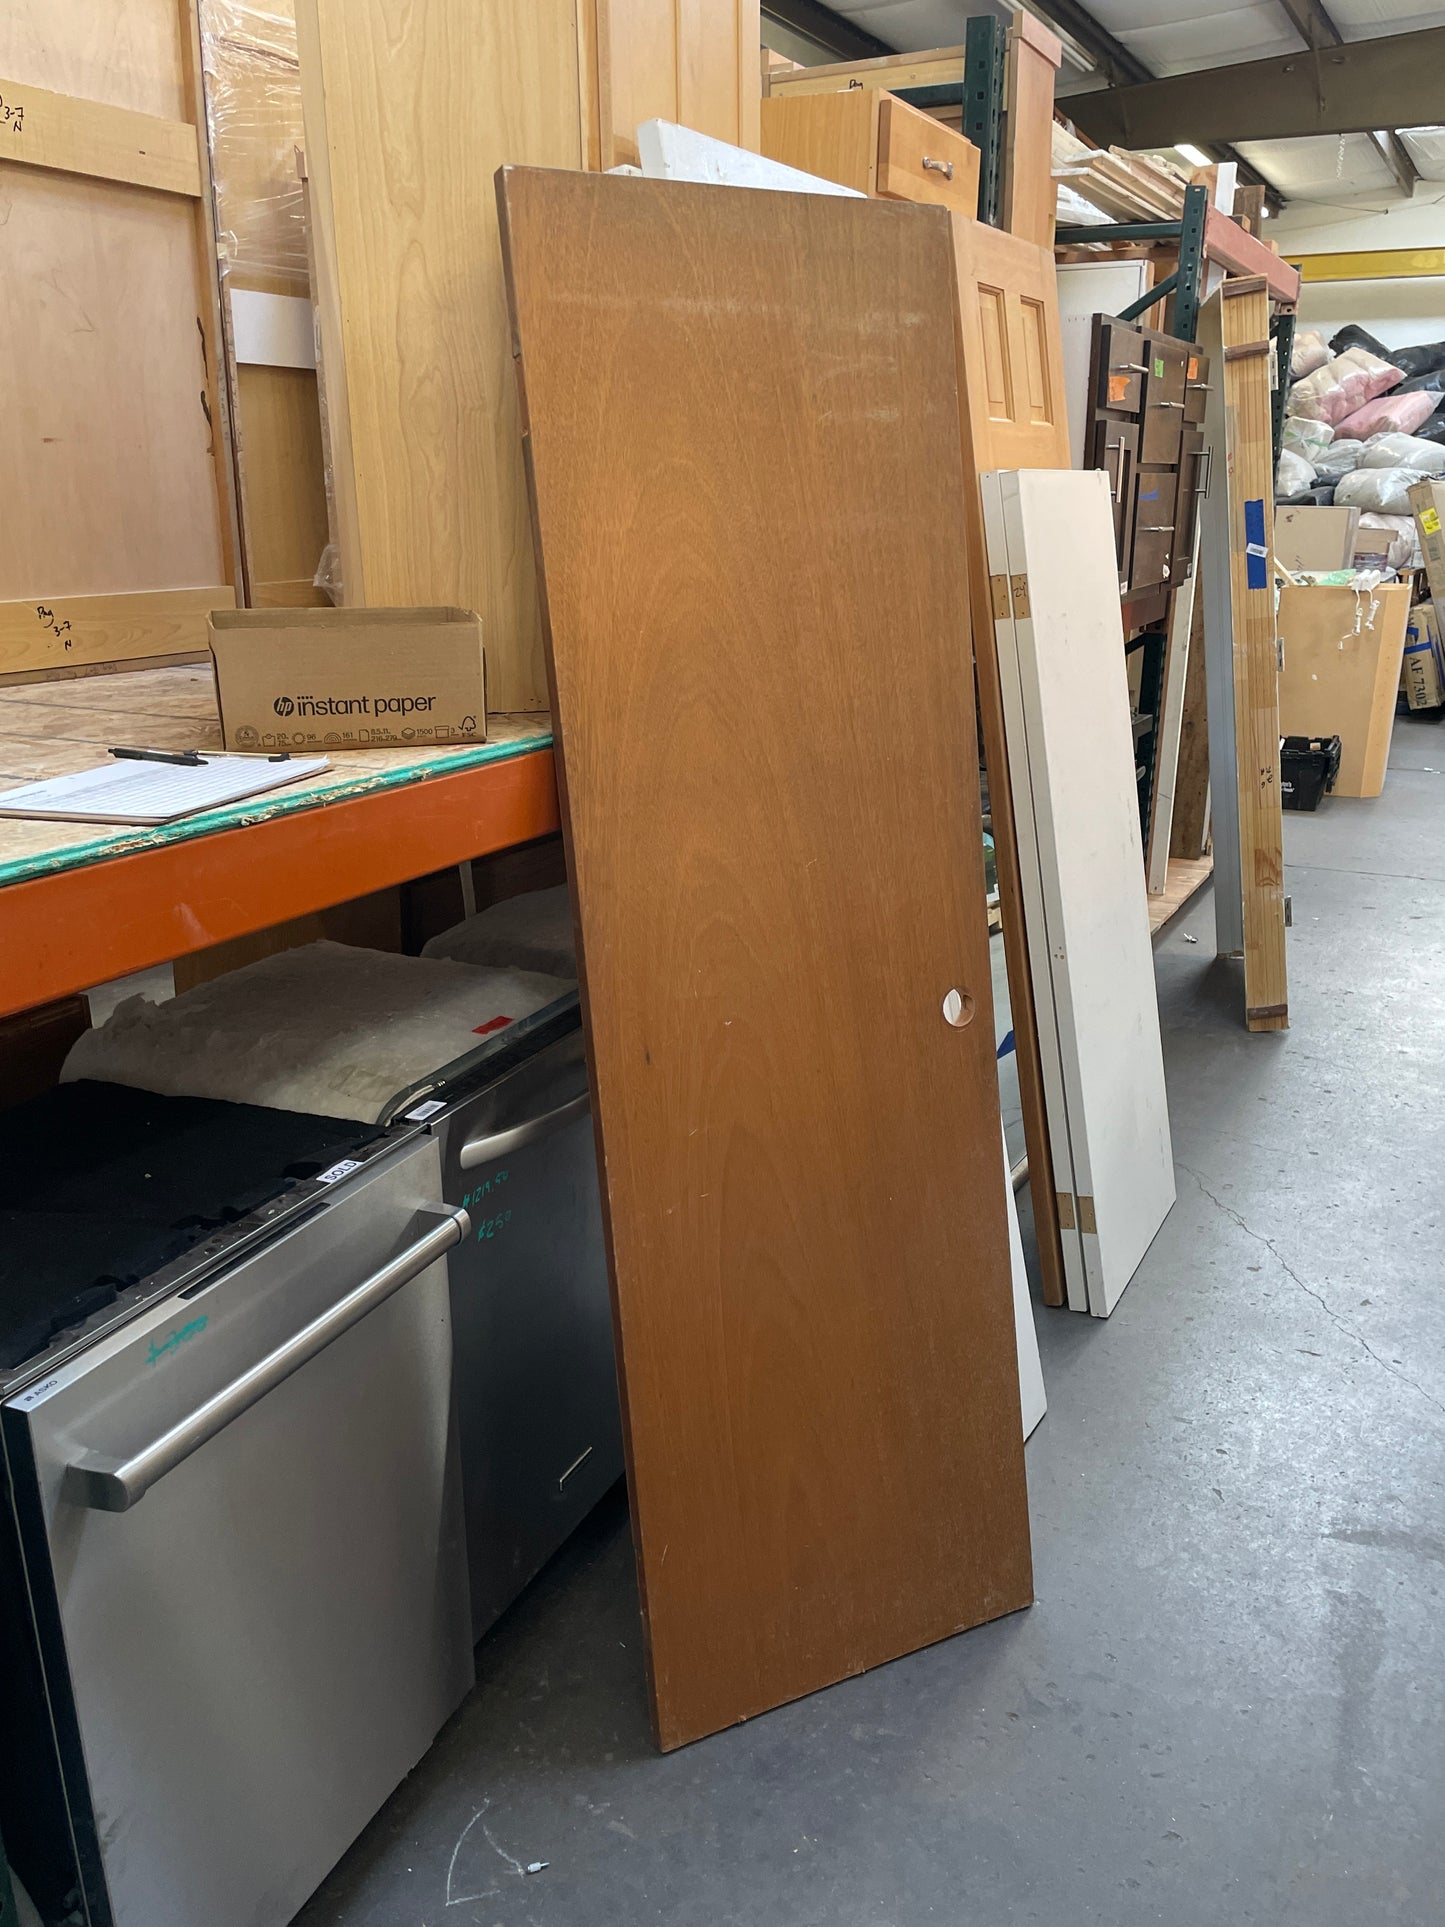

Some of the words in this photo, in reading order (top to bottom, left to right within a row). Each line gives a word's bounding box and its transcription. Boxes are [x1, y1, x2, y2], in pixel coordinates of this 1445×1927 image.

[5, 106, 24, 120] 3-7
[13, 121, 22, 132] N
[53, 621, 72, 637] 3-7
[1409, 656, 1424, 675] AF
[1413, 678, 1427, 706] 7302
[274, 697, 294, 716] hp
[297, 696, 370, 716] instant
[375, 696, 436, 717] paper
[324, 1162, 357, 1180] SOLD
